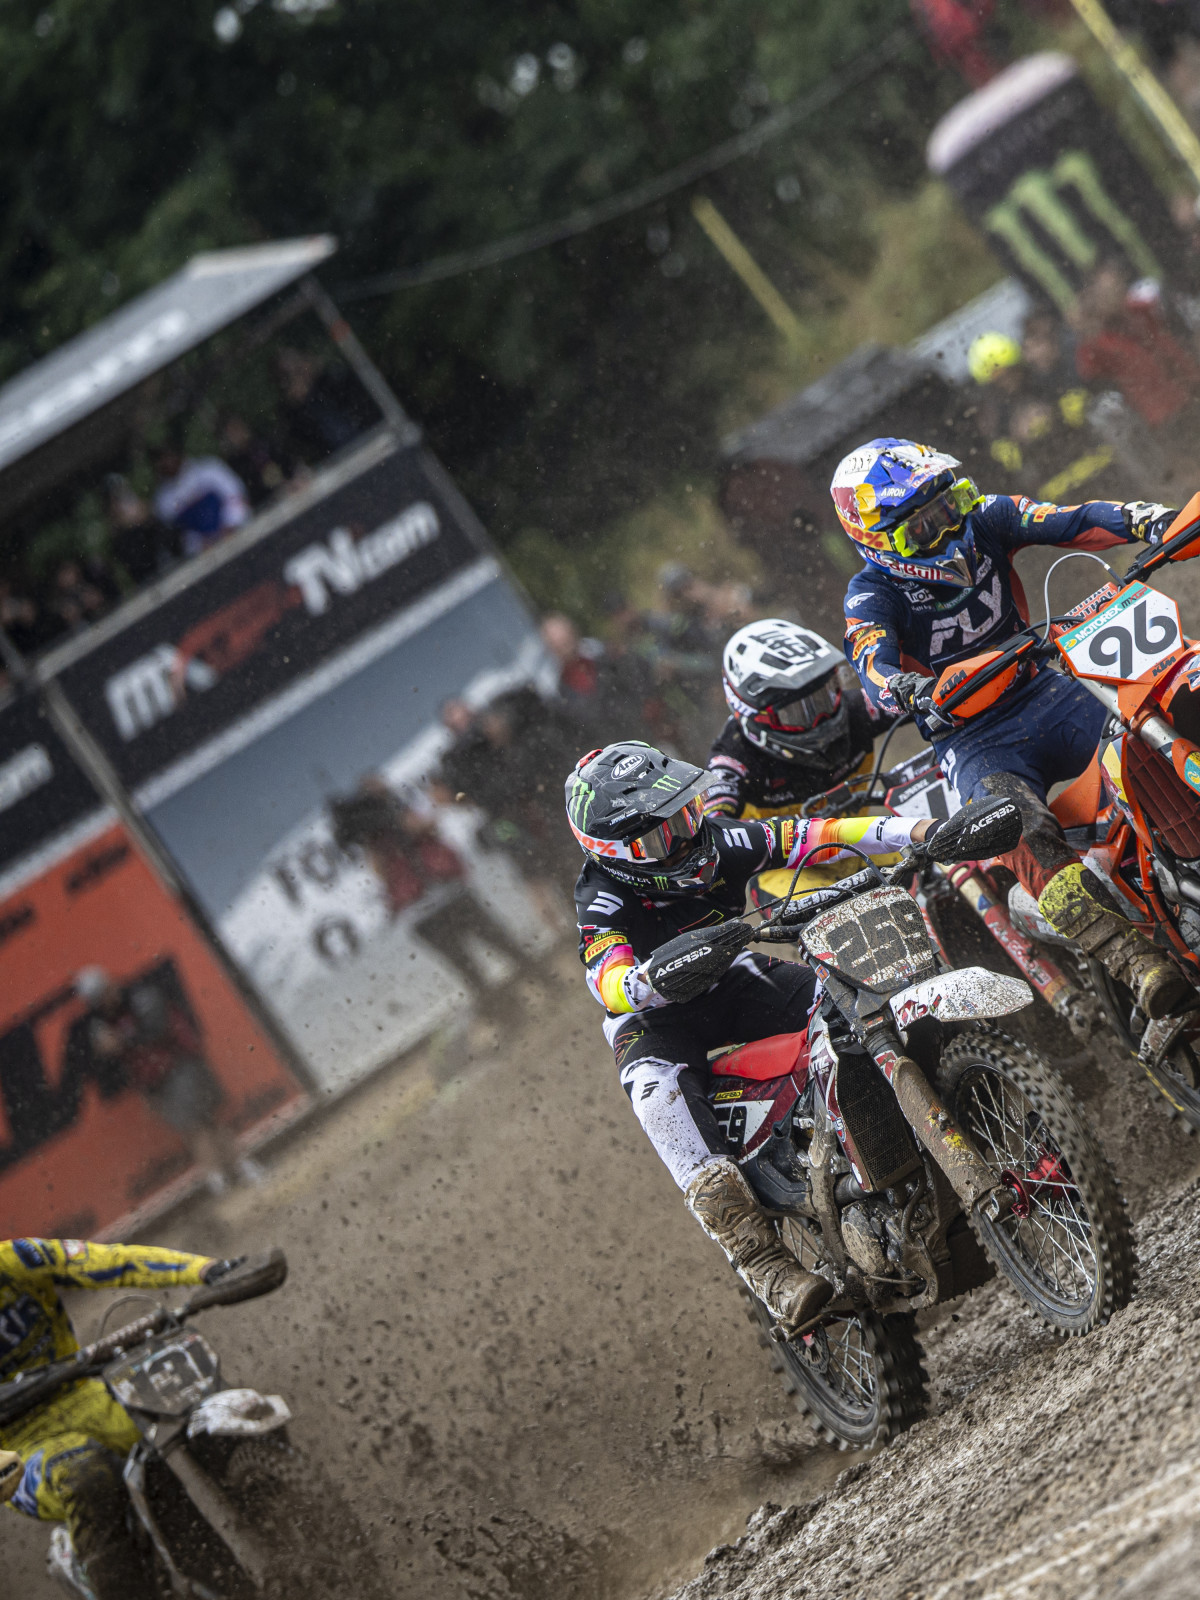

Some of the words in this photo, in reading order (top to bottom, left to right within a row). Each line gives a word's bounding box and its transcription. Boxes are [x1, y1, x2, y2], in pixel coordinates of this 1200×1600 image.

[880, 487, 906, 498] AIROH
[903, 562, 942, 581] Bull
[929, 570, 1003, 657] FLY
[1074, 604, 1123, 641] MOTOREX
[1089, 600, 1178, 680] 96
[1152, 655, 1177, 678] KTM
[939, 669, 968, 701] KTM
[616, 756, 642, 776] Arai
[970, 803, 1016, 835] ACERBIS
[655, 946, 713, 979] ACERBIS
